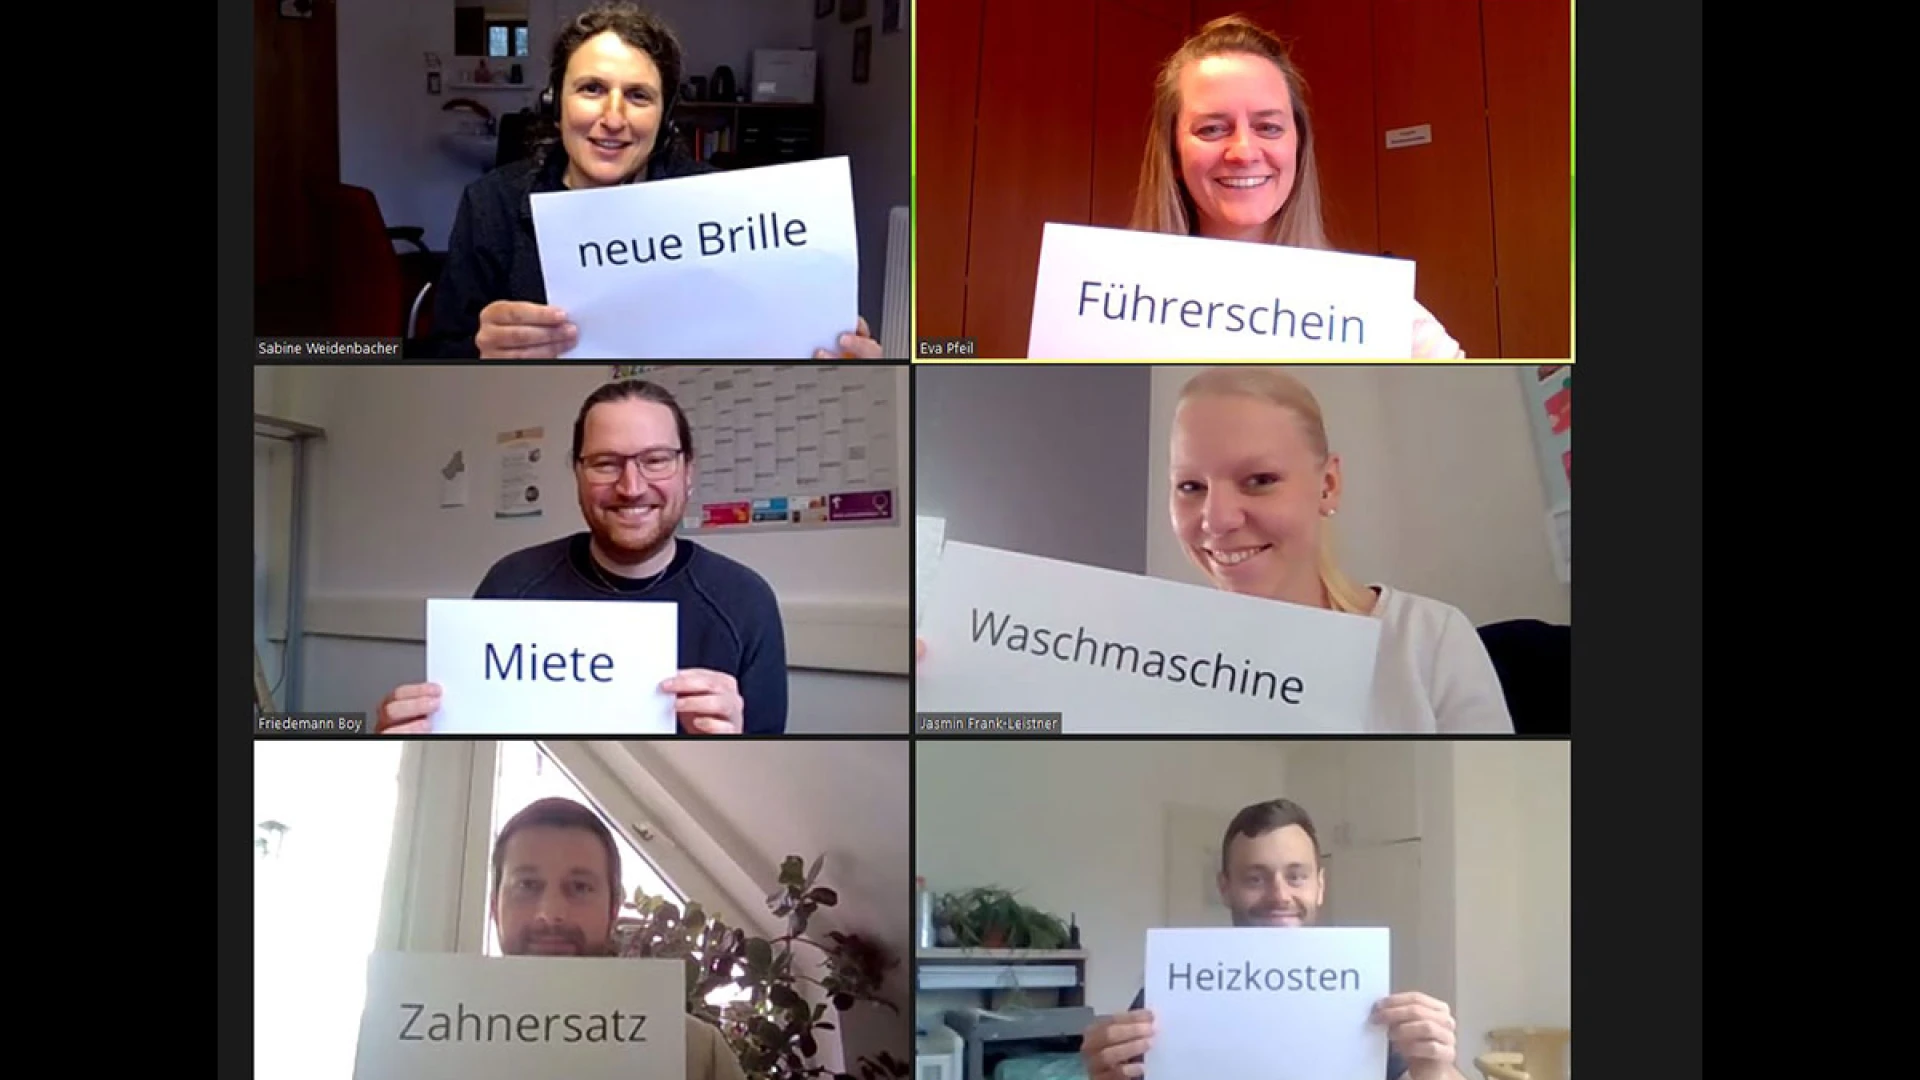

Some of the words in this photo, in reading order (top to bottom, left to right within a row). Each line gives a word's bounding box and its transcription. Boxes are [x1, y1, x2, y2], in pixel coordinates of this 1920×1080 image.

[579, 233, 682, 268] neue
[698, 211, 808, 257] Brille
[1077, 280, 1365, 344] Führerschein
[484, 643, 615, 683] Miete
[970, 608, 1305, 706] Waschmaschine
[1168, 961, 1360, 991] Heizkosten
[399, 1002, 648, 1042] Zahnersatz
